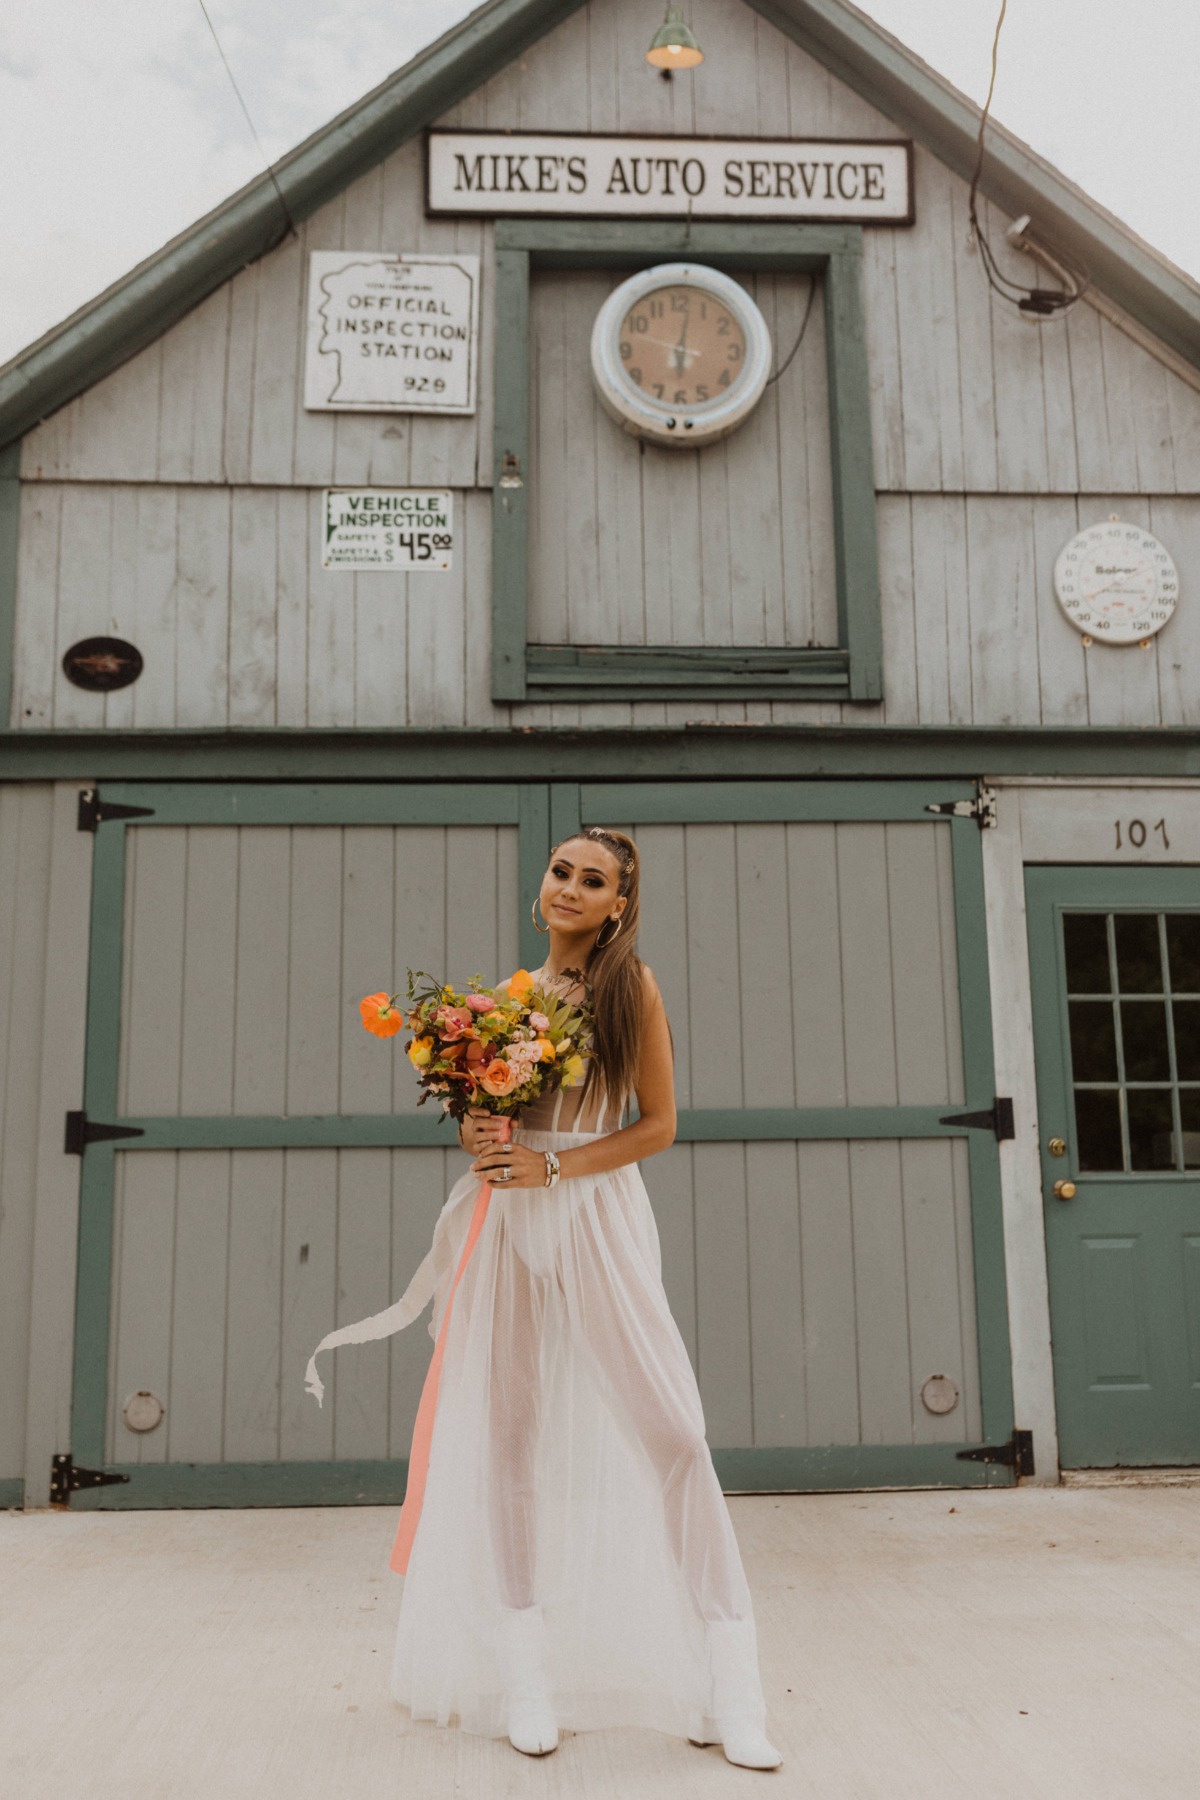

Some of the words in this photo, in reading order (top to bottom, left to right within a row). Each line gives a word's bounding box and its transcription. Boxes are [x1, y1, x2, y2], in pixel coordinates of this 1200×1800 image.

[453, 154, 588, 194] MIKE'S
[605, 157, 706, 197] AUTO
[724, 160, 885, 200] SERVICE
[347, 295, 452, 316] OFFICIAL
[651, 301, 664, 318] 11
[670, 294, 689, 312] 12
[701, 303, 707, 319] 1
[337, 318, 466, 341] INSPECTION
[629, 315, 648, 333] 10
[717, 317, 730, 335] 2
[361, 342, 453, 362] STATION
[619, 342, 632, 360] 9
[727, 344, 740, 361] 3
[718, 368, 731, 386] 4
[652, 383, 665, 400] 7
[673, 390, 687, 405] 6
[695, 385, 708, 401] 5
[348, 497, 439, 511] VEHICLE
[340, 513, 446, 527] INSPECTION
[1114, 818, 1170, 850] 101
